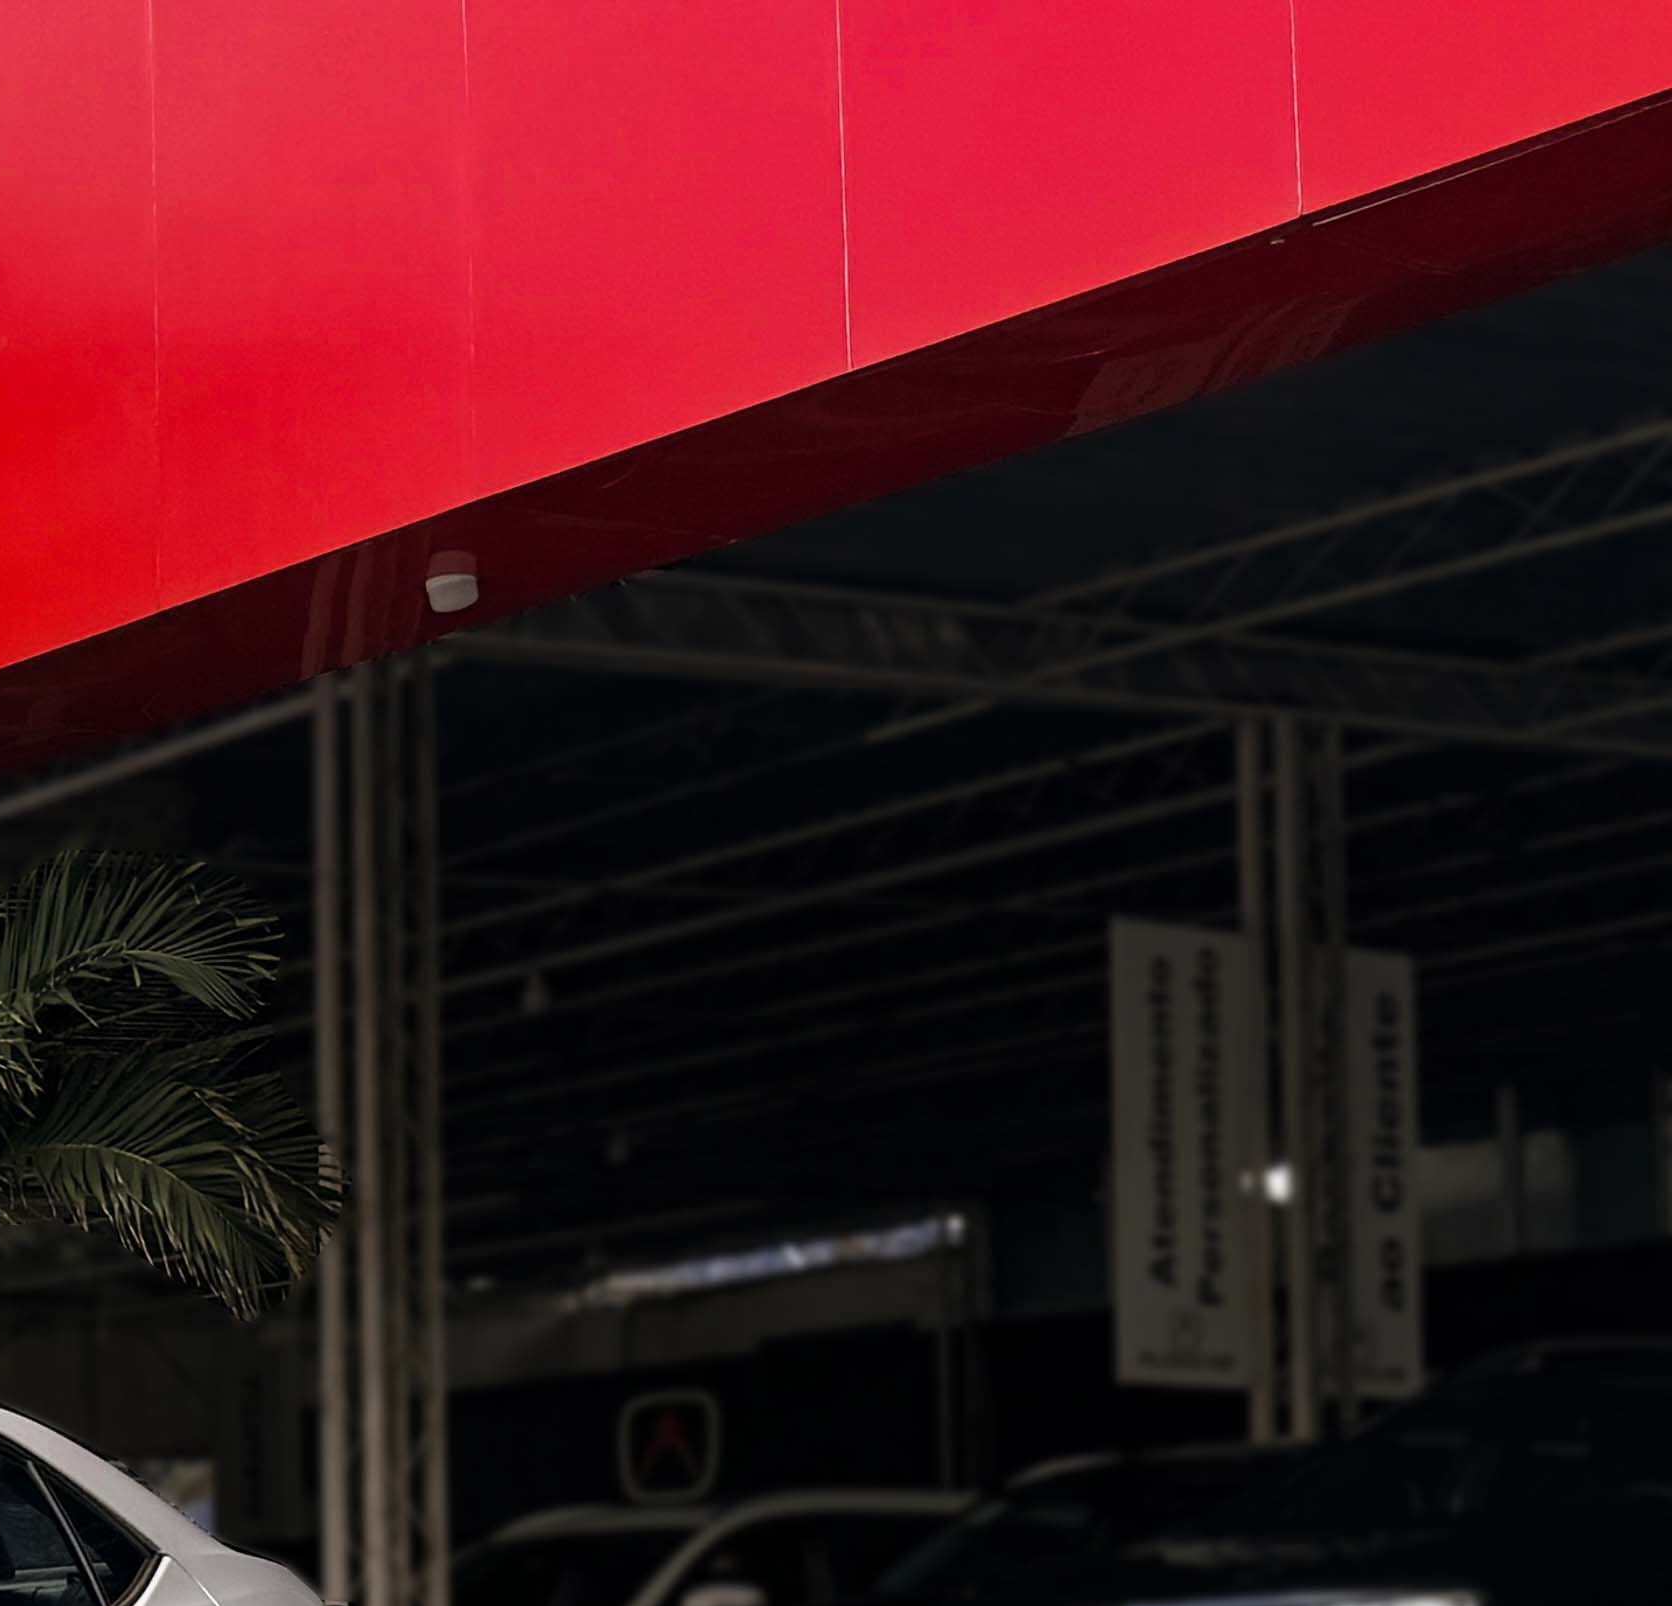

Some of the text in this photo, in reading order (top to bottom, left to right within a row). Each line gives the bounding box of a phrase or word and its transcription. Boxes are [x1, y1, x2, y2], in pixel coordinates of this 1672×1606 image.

[1147, 954, 1176, 1289] Atendimento
[1194, 946, 1223, 1306] Personalizado
[1371, 991, 1401, 1214] Cliente
